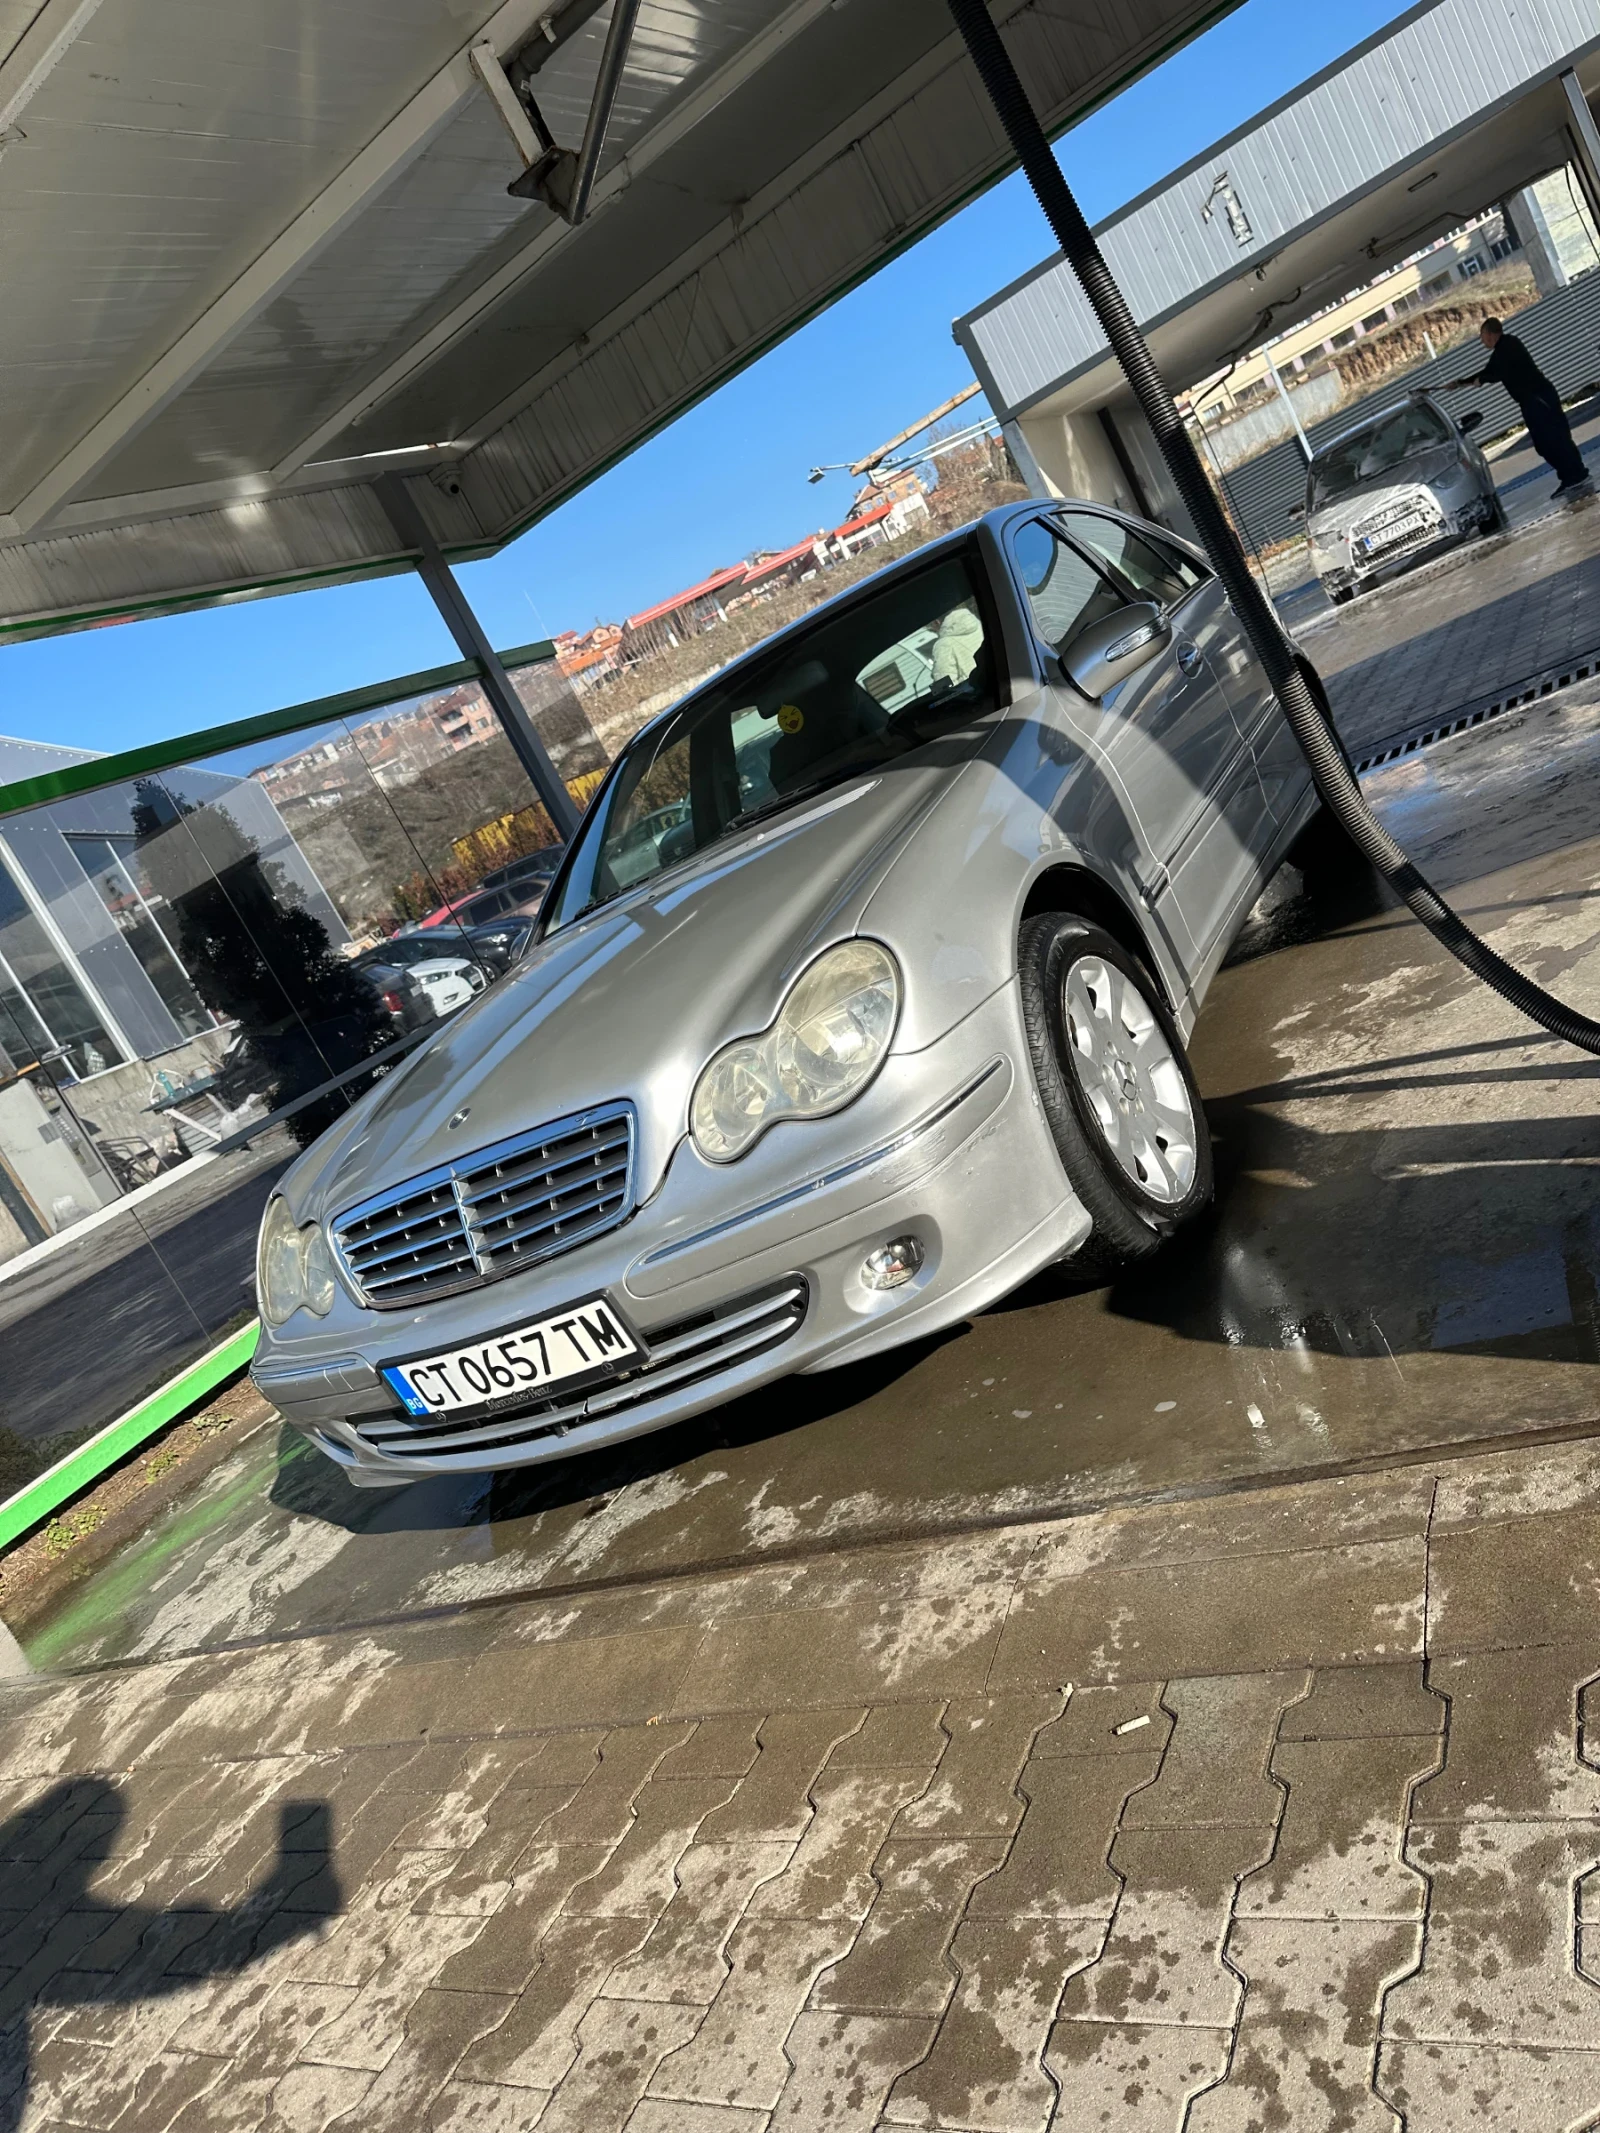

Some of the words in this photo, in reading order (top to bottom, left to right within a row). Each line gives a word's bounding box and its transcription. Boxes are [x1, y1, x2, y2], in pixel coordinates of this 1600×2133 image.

[1371, 533, 1383, 545] CT
[409, 1363, 463, 1407] CT
[458, 1331, 552, 1394] 0657
[551, 1308, 628, 1362] TM
[406, 1396, 424, 1410] BG
[485, 1385, 553, 1411] Mercedes-Benz
